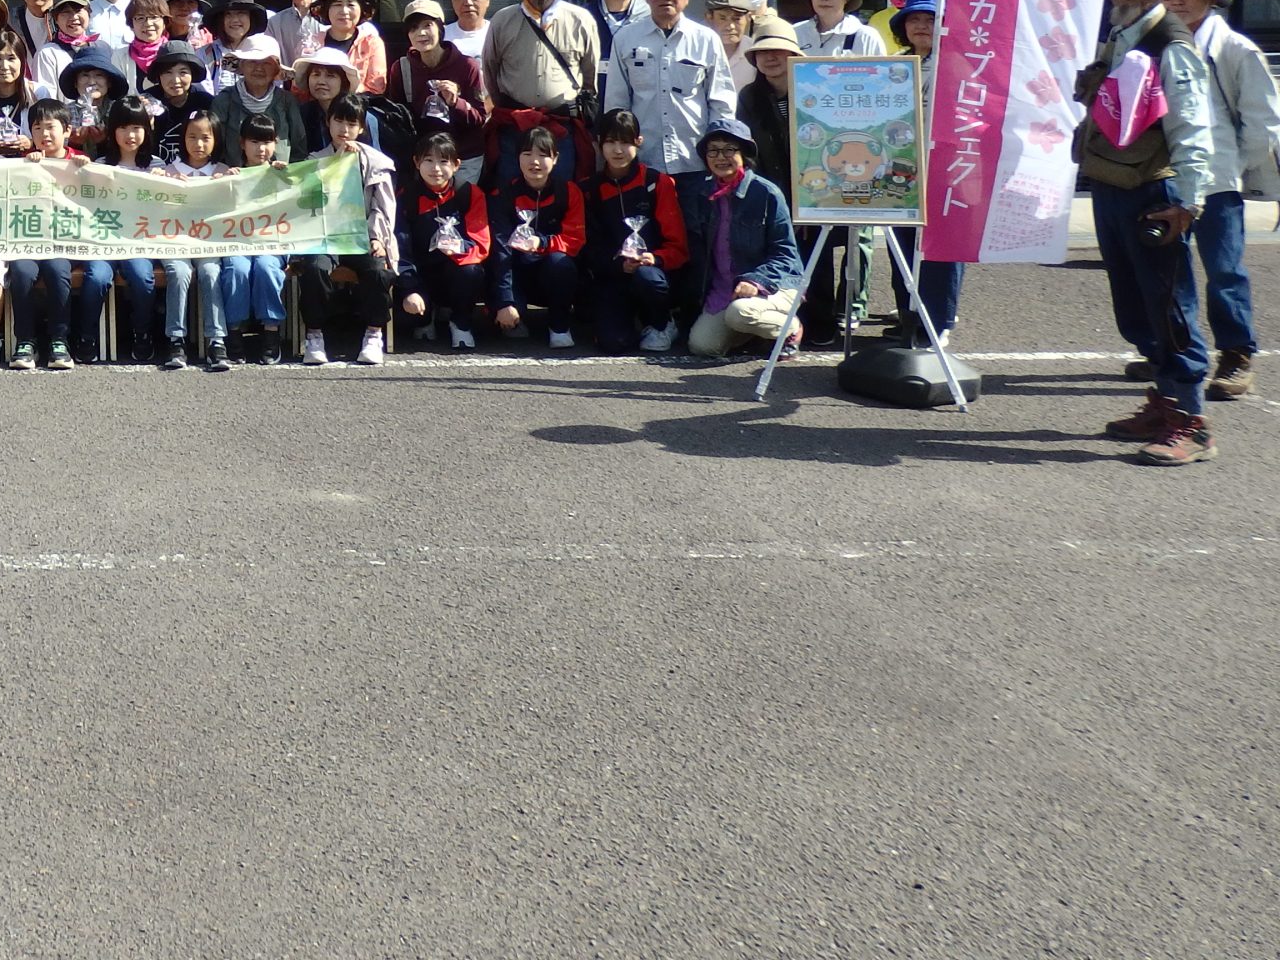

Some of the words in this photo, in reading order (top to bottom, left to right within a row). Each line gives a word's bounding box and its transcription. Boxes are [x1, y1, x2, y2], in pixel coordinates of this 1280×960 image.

[820, 93, 909, 108] 全国植樹祭
[133, 216, 212, 240] えひめ
[222, 212, 292, 239] 2026
